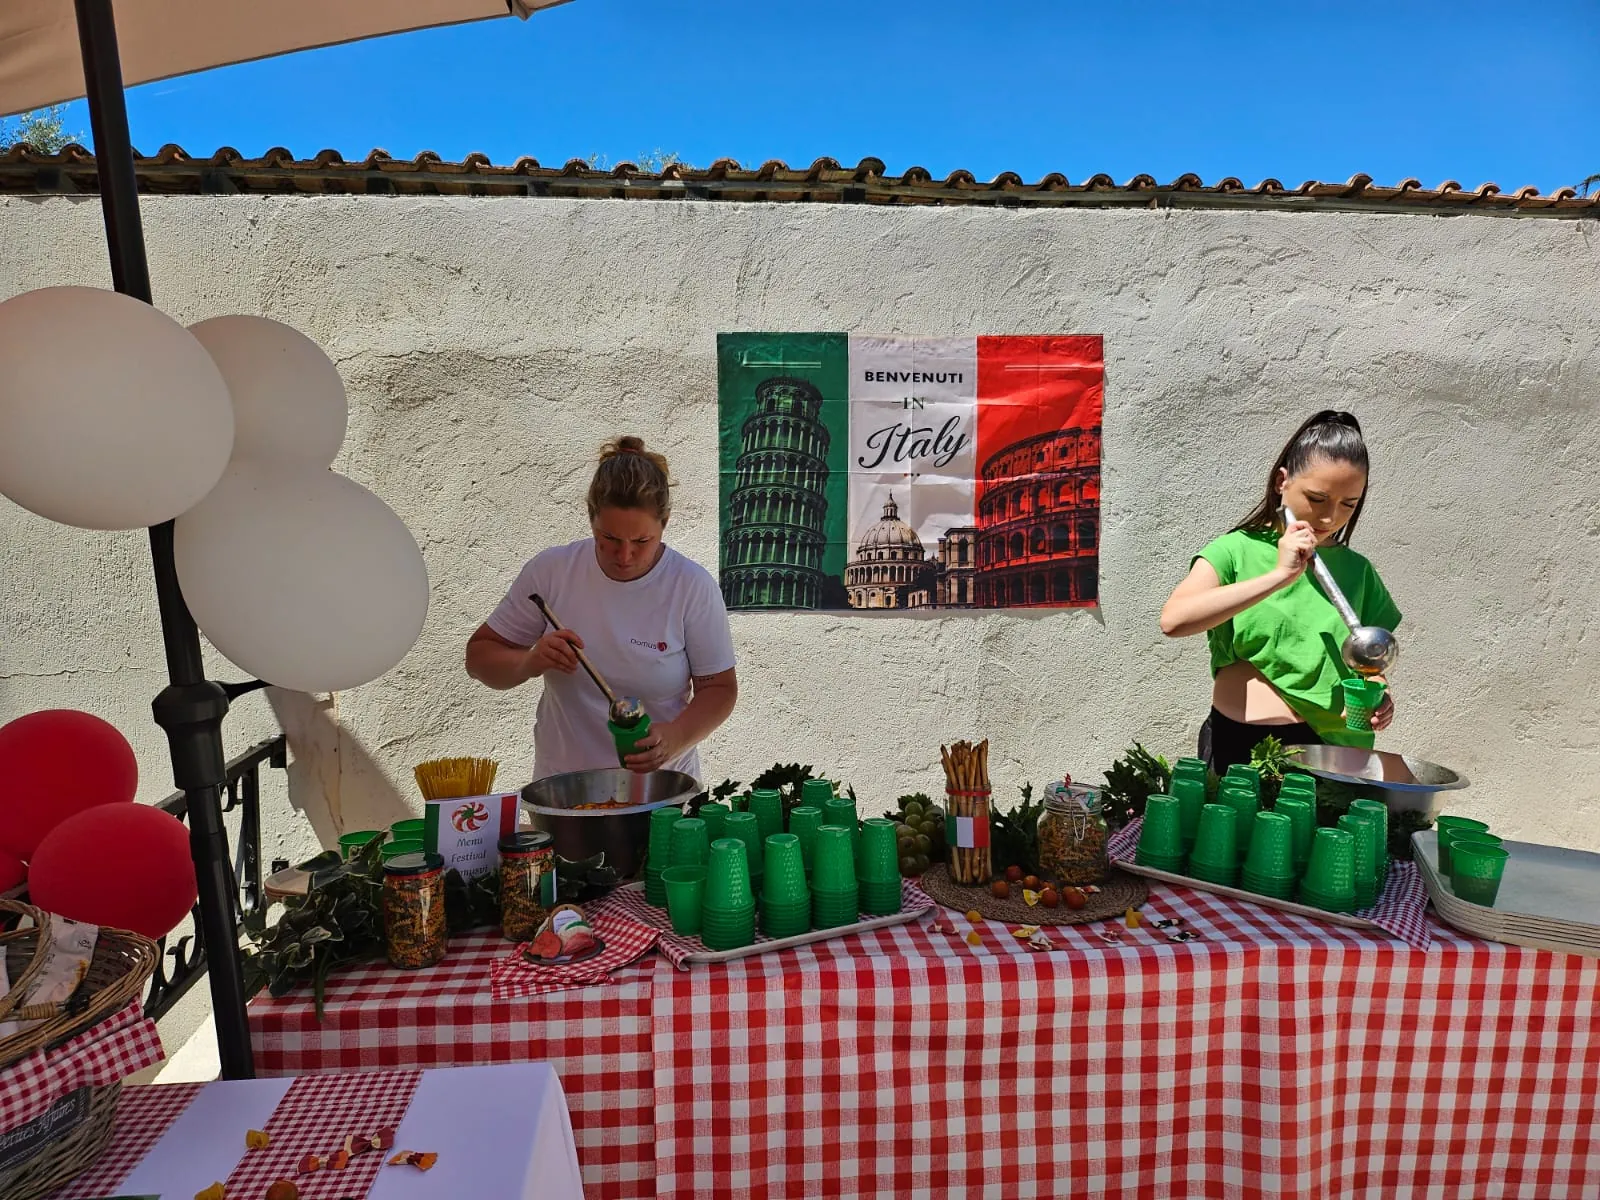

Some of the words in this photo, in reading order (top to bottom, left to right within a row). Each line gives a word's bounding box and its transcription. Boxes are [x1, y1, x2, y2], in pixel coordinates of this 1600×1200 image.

[864, 371, 963, 384] BENVENUTI
[858, 415, 970, 469] Italy
[457, 837, 483, 848] Menu
[451, 849, 486, 863] Festival
